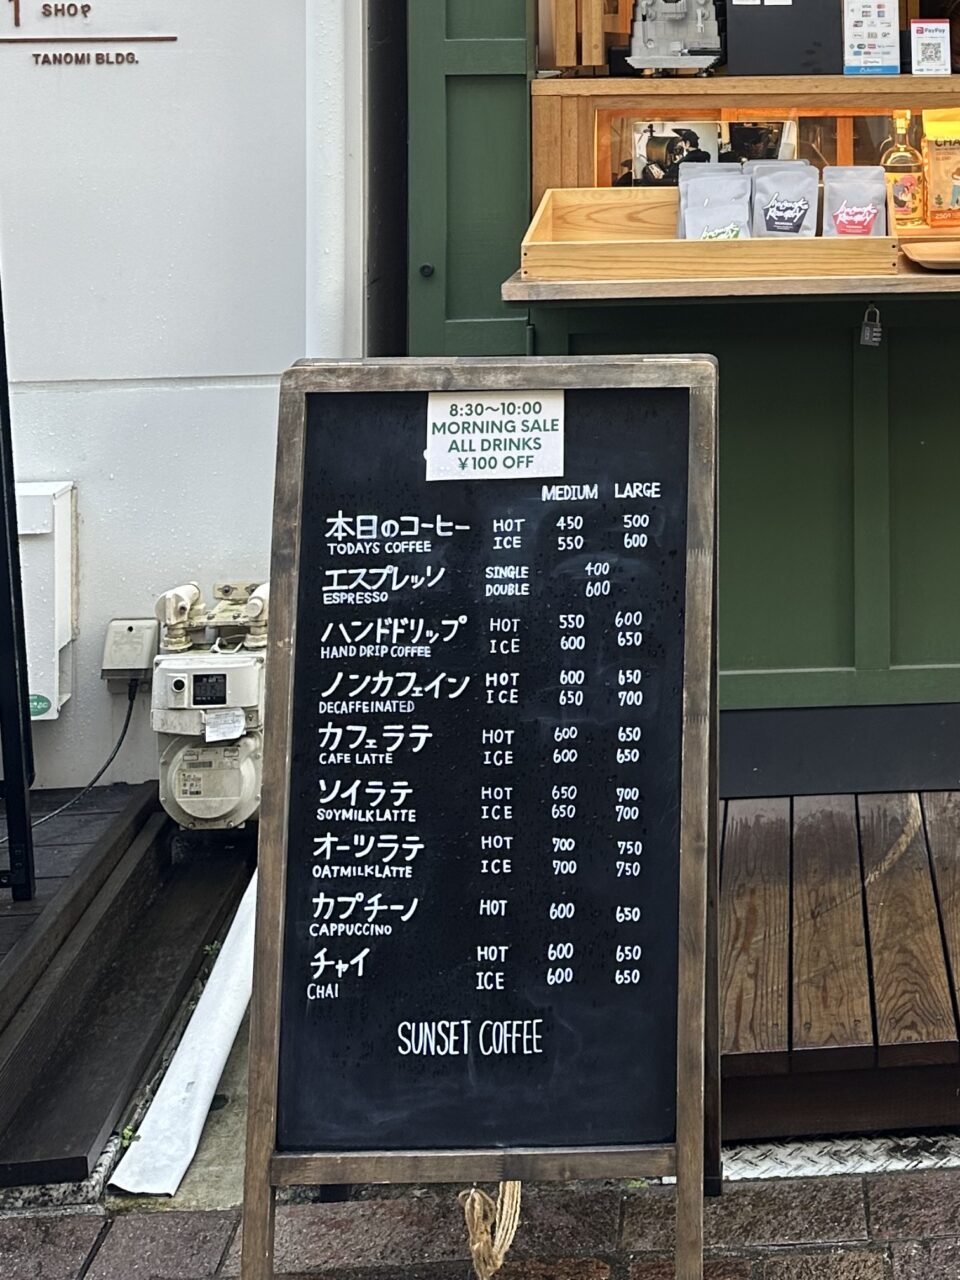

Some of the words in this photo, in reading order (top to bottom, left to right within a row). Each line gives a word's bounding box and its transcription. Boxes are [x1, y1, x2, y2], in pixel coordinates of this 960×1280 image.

[42, 4, 91, 18] SHOP
[32, 53, 90, 65] TANOMI
[96, 52, 139, 65] BLDG.
[432, 420, 516, 435] MORNING
[521, 419, 559, 432] SALE
[448, 439, 476, 452] ALL
[481, 437, 541, 451] DRINKS
[503, 455, 534, 469] OFF
[542, 484, 598, 501] MEDIUM
[615, 483, 660, 498] LARGE
[325, 510, 470, 541] 本日のコーヒー
[494, 519, 525, 532] HOT
[556, 516, 583, 530] 450
[624, 515, 649, 528] 500
[327, 542, 380, 555] TODAYS
[385, 541, 431, 553] COFFEE
[493, 536, 521, 549] ICE
[558, 536, 583, 550] 550
[624, 533, 647, 548] 600
[322, 565, 445, 591] エスプレッソ
[486, 566, 528, 579] SINGLE
[585, 562, 609, 575] 400
[486, 583, 529, 596] DOUBLE
[586, 580, 610, 597] 600
[323, 592, 388, 604] ESPRESSO
[321, 615, 467, 643] ハンドドリップ
[490, 618, 520, 632] HOT
[560, 615, 584, 628] 550
[615, 611, 642, 627] 600
[321, 646, 356, 658] HAND
[360, 645, 388, 657] DRIP
[391, 646, 431, 657] COFFEE
[490, 639, 519, 654] ICE
[561, 636, 585, 650] 600
[618, 632, 642, 646] 650
[322, 670, 470, 698] ノンカフェイン
[486, 673, 519, 686] HOT
[560, 670, 584, 684] 600
[619, 670, 641, 685] 650
[487, 689, 518, 703] ICE
[560, 690, 583, 705] 650
[618, 691, 642, 706] 700
[319, 700, 414, 714] DECAFFEINATED
[319, 722, 432, 752] カフェラテ
[483, 729, 514, 744] HOT
[554, 727, 577, 742] 600
[618, 727, 641, 741] 650
[319, 753, 351, 764] CAFE
[356, 753, 392, 764] LATTE
[484, 751, 513, 766] ICE
[553, 749, 577, 763] 600
[617, 749, 639, 763] 650
[319, 780, 412, 806] ソイラテ
[482, 787, 512, 799] HOT
[552, 786, 577, 799] 650
[616, 788, 639, 802] 700
[482, 805, 512, 820] ICE
[552, 804, 575, 818] 650
[616, 806, 639, 822] 700
[313, 832, 424, 862] オーツラテ
[481, 836, 513, 849] HOT
[552, 838, 575, 852] 700
[618, 841, 642, 855] 750
[481, 859, 511, 873] ICE
[553, 860, 576, 874] 700
[616, 861, 640, 877] 750
[312, 892, 418, 922] カプチーノ
[480, 900, 507, 916] HOT
[550, 903, 574, 919] 600
[616, 906, 640, 922] 650
[309, 923, 392, 936] CAPPUCCINO
[311, 948, 369, 979] チャイ
[477, 946, 508, 962] HOT
[548, 943, 573, 960] 600
[616, 945, 641, 962] 650
[476, 972, 504, 989] ICE
[547, 968, 573, 985] 600
[615, 970, 640, 984] 650
[307, 983, 338, 999] CHAI
[398, 1020, 471, 1055] SUNSET
[479, 1019, 542, 1055] COFFEE
